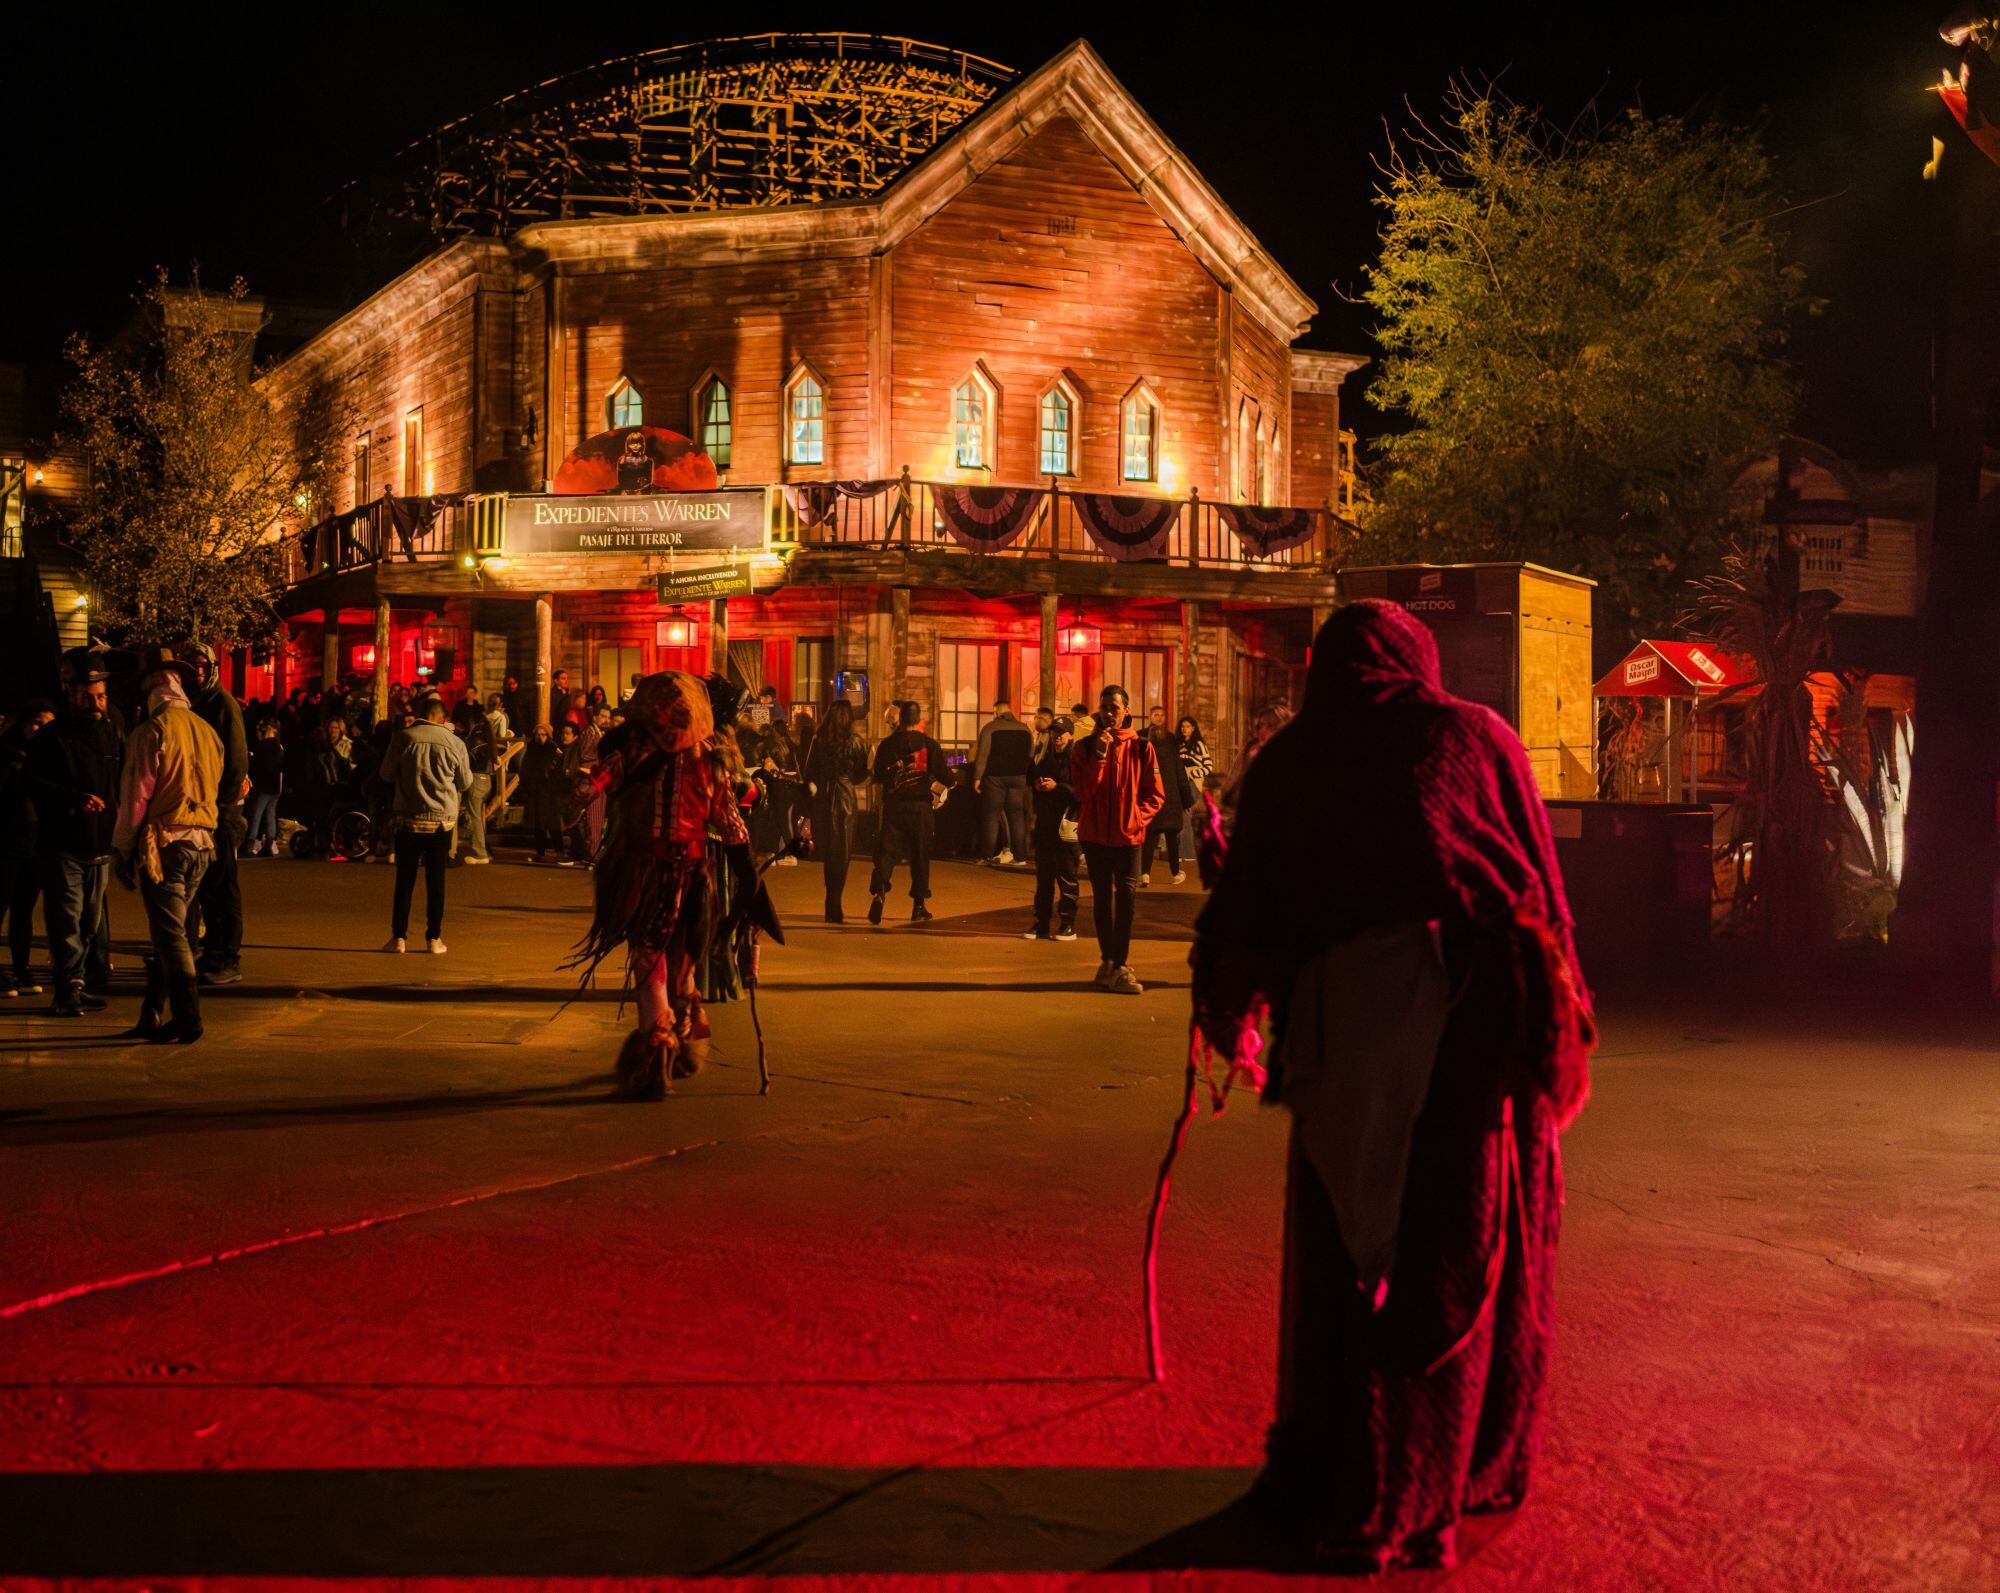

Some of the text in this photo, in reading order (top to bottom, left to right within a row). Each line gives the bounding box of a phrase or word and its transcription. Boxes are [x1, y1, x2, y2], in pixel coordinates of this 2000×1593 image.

[533, 499, 732, 525] EXPEDIENTES WARREN
[579, 532, 683, 547] PASAJE DEL TERROR
[675, 576, 697, 584] AHORA
[697, 570, 738, 582] INCLUYENDO
[663, 583, 712, 597] EXPEDIENTE
[712, 578, 747, 591] WARREN
[1630, 660, 1654, 672] Oscar
[1628, 667, 1655, 681] Mayer
